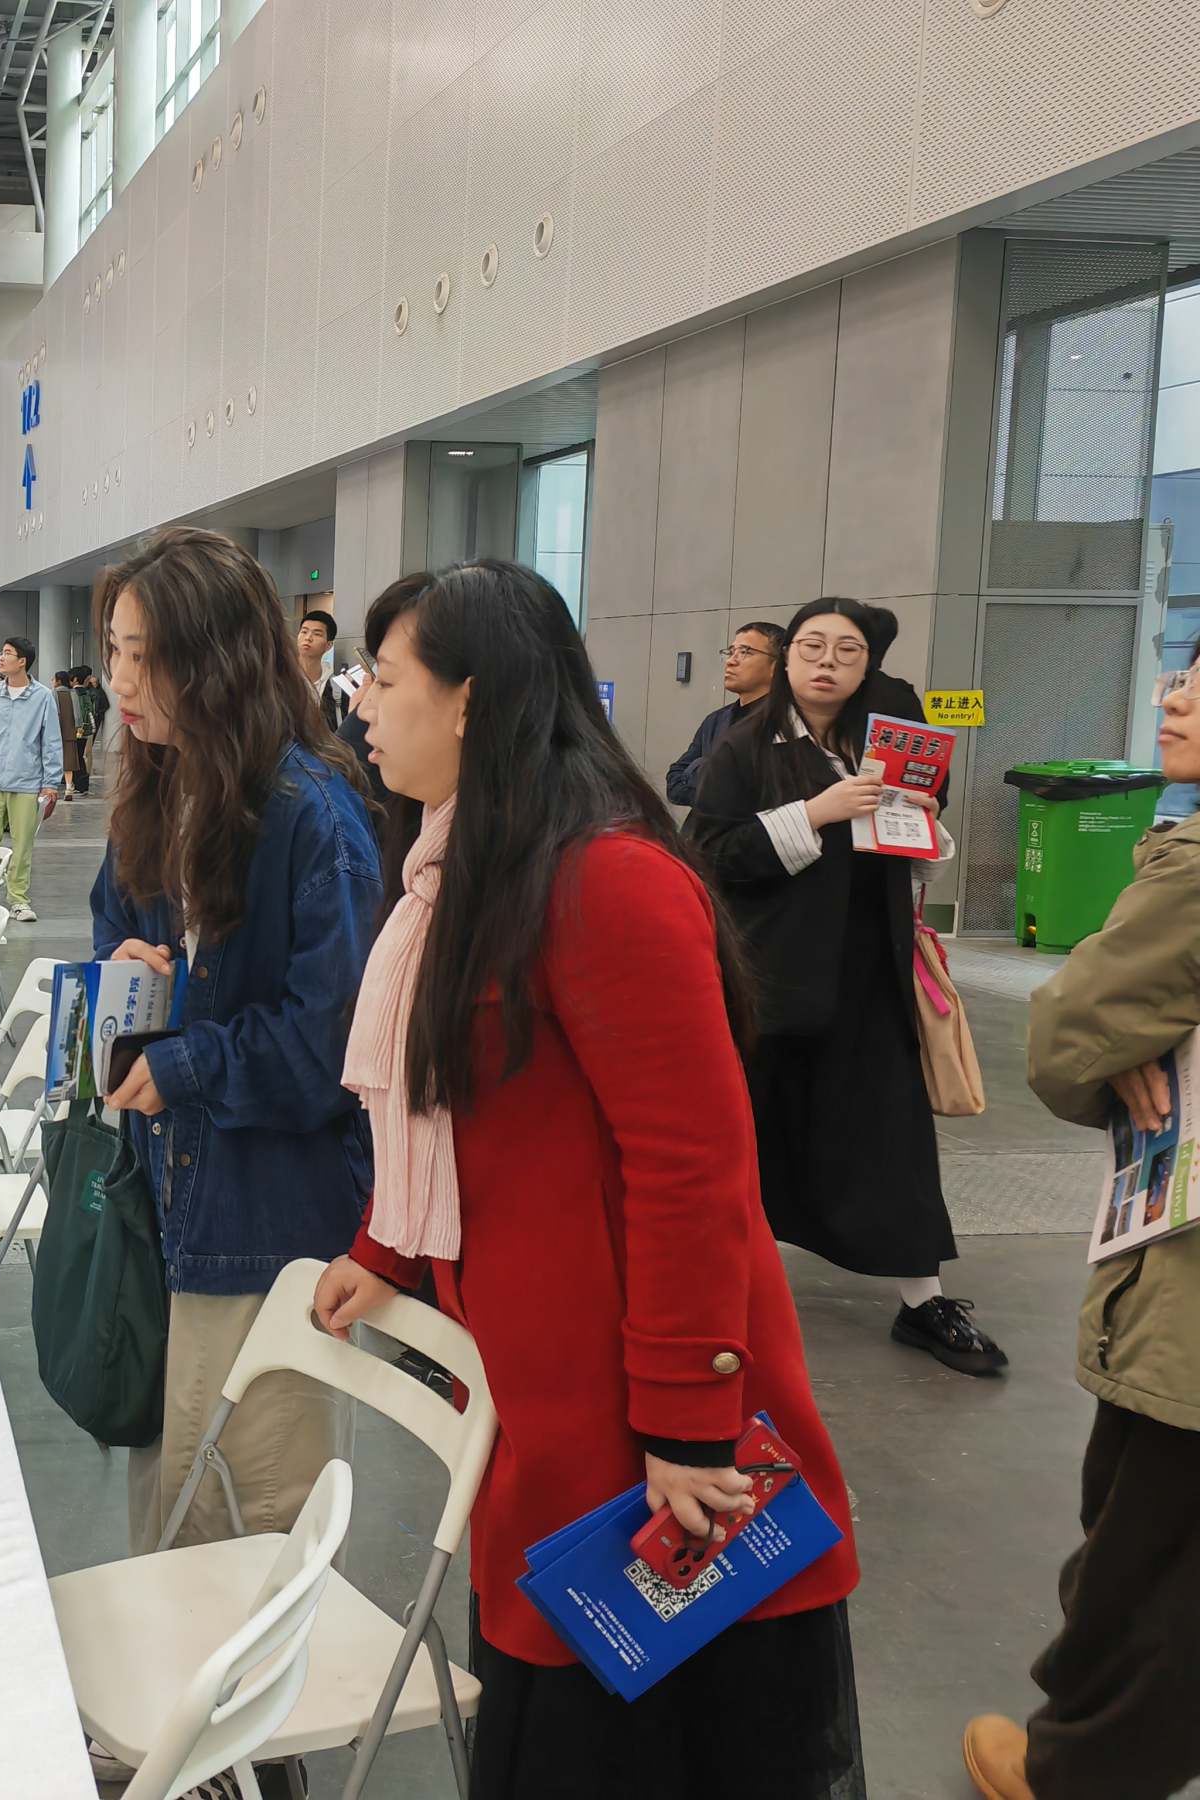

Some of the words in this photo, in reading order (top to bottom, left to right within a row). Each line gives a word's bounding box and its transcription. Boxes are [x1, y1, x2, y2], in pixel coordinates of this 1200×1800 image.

[930, 696, 983, 710] 禁止进入
[950, 712, 975, 721] entry!
